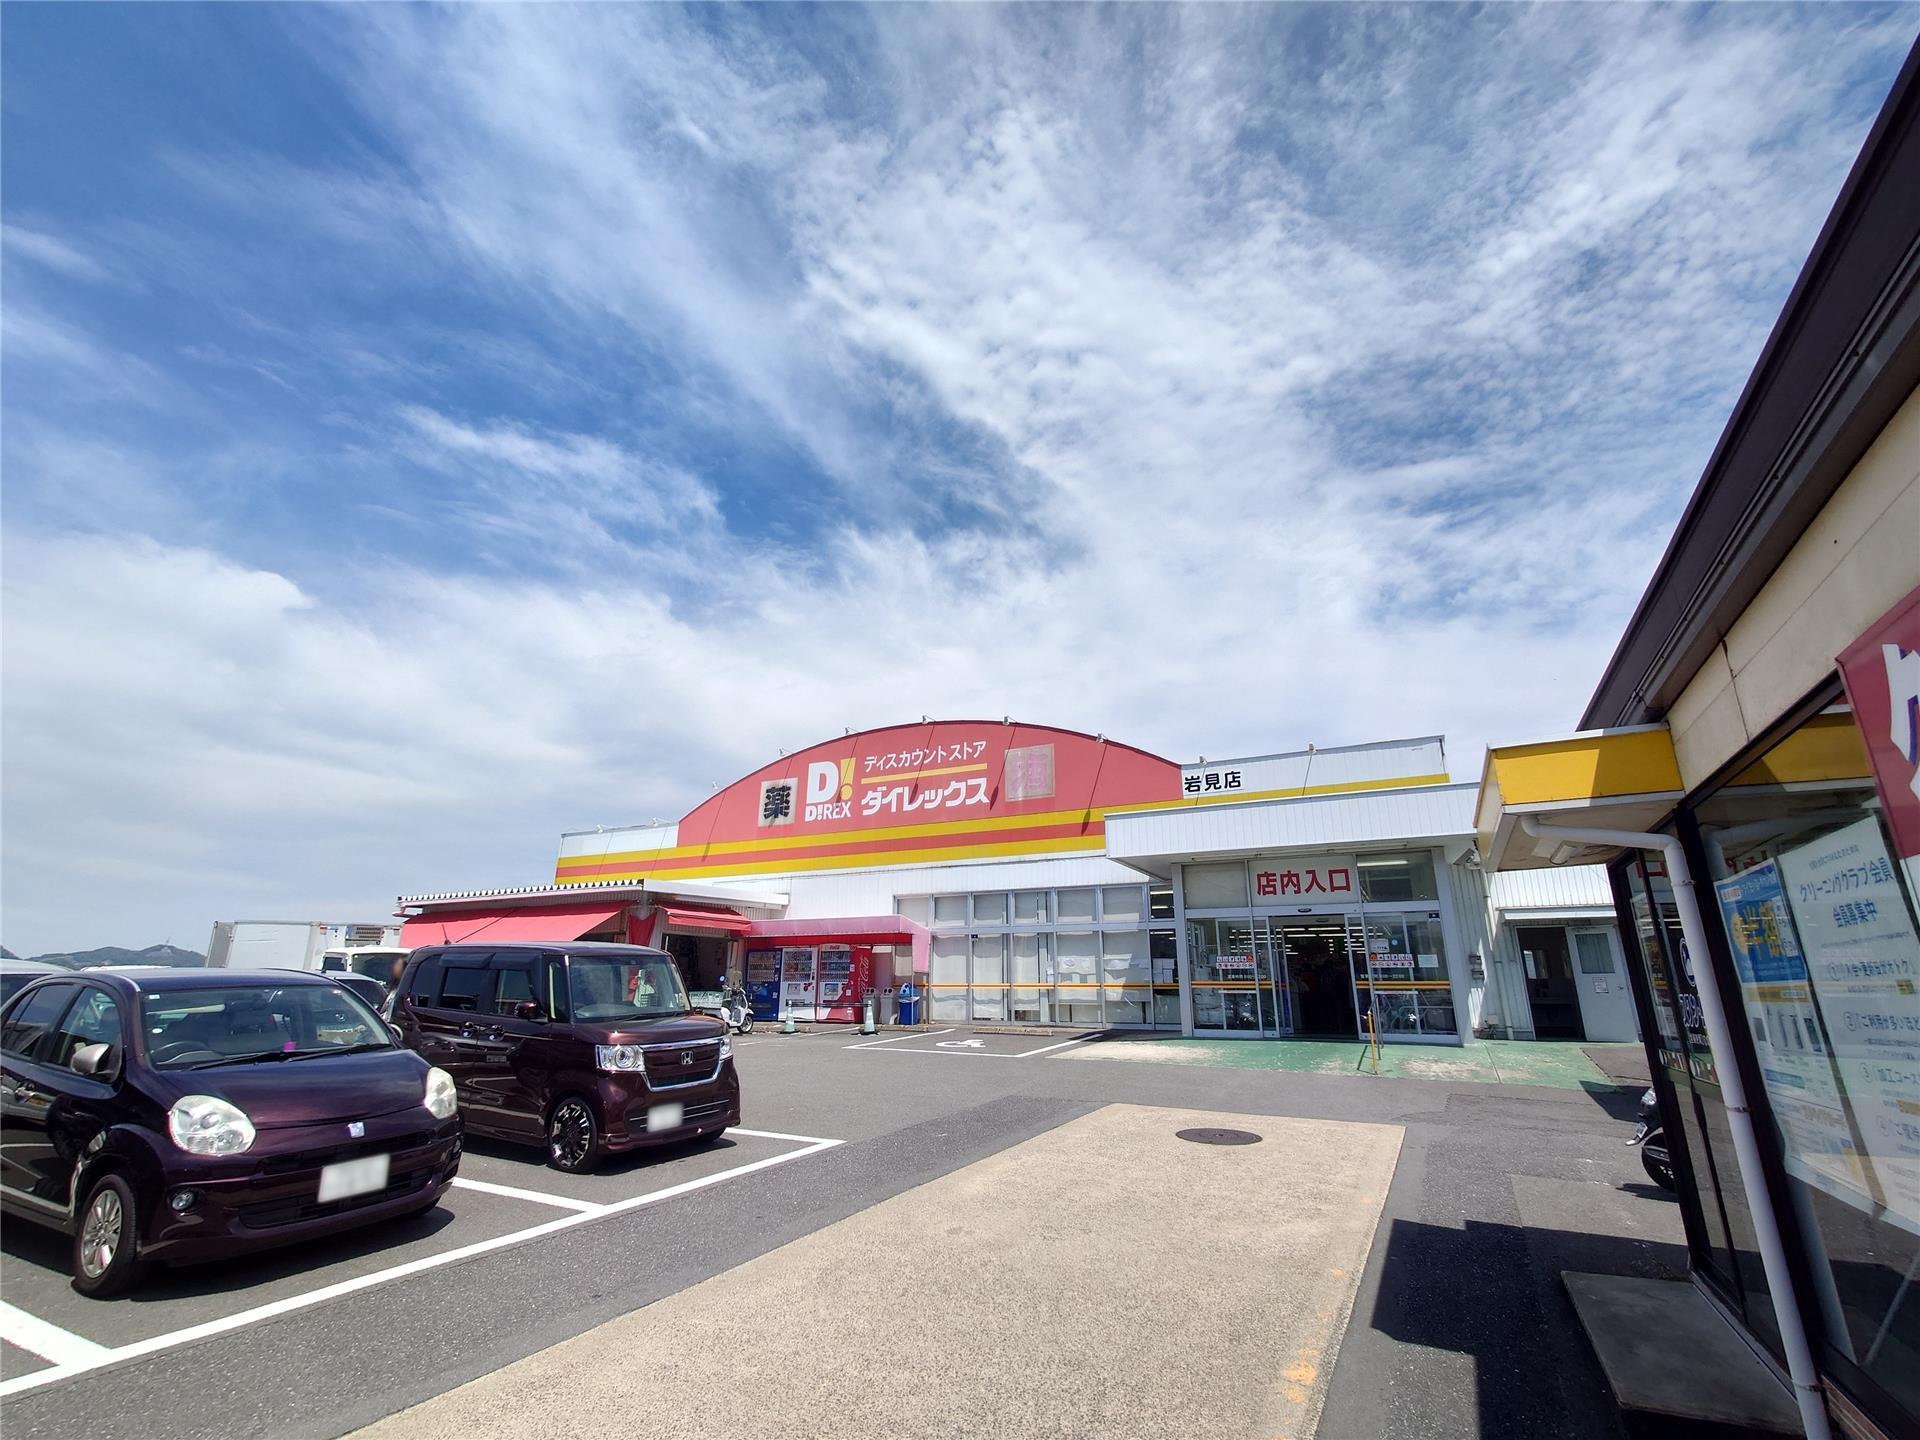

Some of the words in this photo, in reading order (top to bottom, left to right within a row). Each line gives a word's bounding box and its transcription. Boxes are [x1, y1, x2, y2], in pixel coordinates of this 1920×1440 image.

[861, 777, 990, 816] ダイレックス
[1184, 770, 1242, 793] 岩見店
[763, 785, 792, 820] 薬
[1256, 868, 1352, 896] 店内入口
